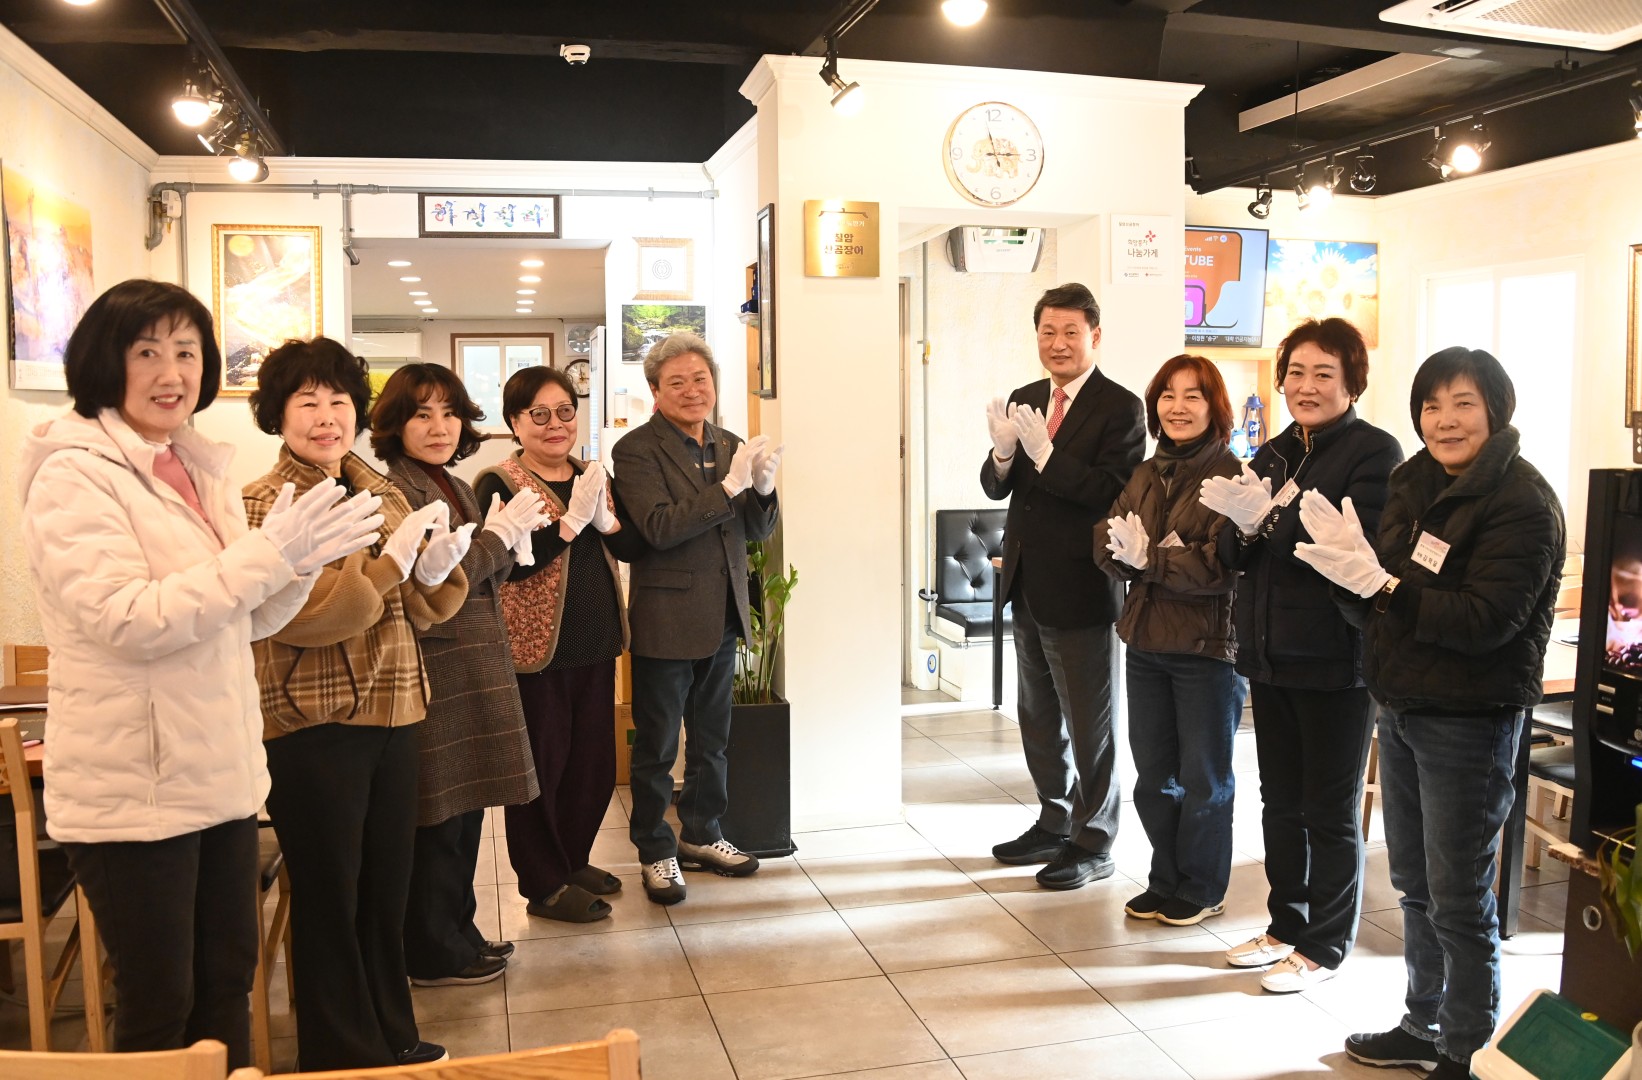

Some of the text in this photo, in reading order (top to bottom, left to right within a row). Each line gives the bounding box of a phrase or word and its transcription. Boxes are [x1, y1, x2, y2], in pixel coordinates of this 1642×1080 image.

[985, 109, 1002, 122] 12
[952, 147, 962, 160] 9
[1025, 149, 1036, 161] 3
[990, 187, 1001, 200] 6
[835, 233, 854, 243] 칠암
[1127, 248, 1159, 258] 나눔가게
